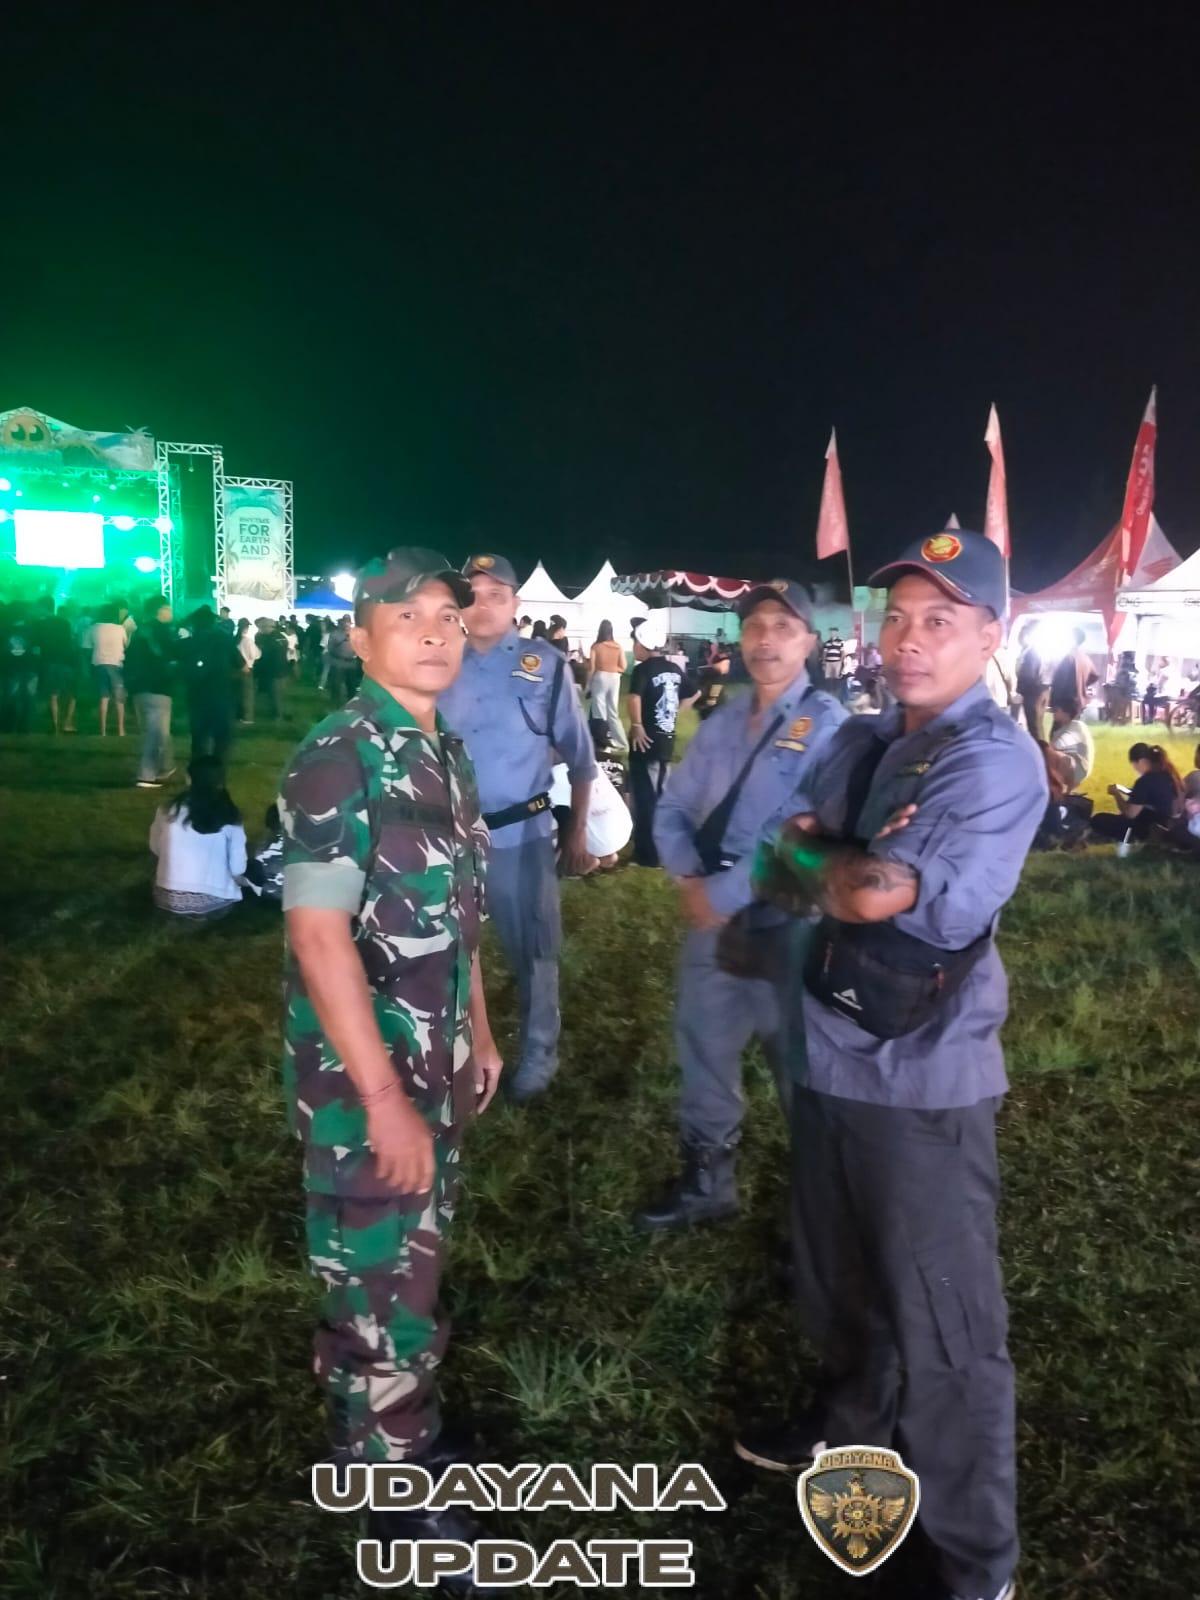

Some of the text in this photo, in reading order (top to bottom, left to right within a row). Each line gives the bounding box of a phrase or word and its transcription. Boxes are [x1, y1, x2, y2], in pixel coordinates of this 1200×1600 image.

[240, 524, 270, 536] FOR
[240, 536, 270, 544] EARTH
[241, 545, 270, 555] AND
